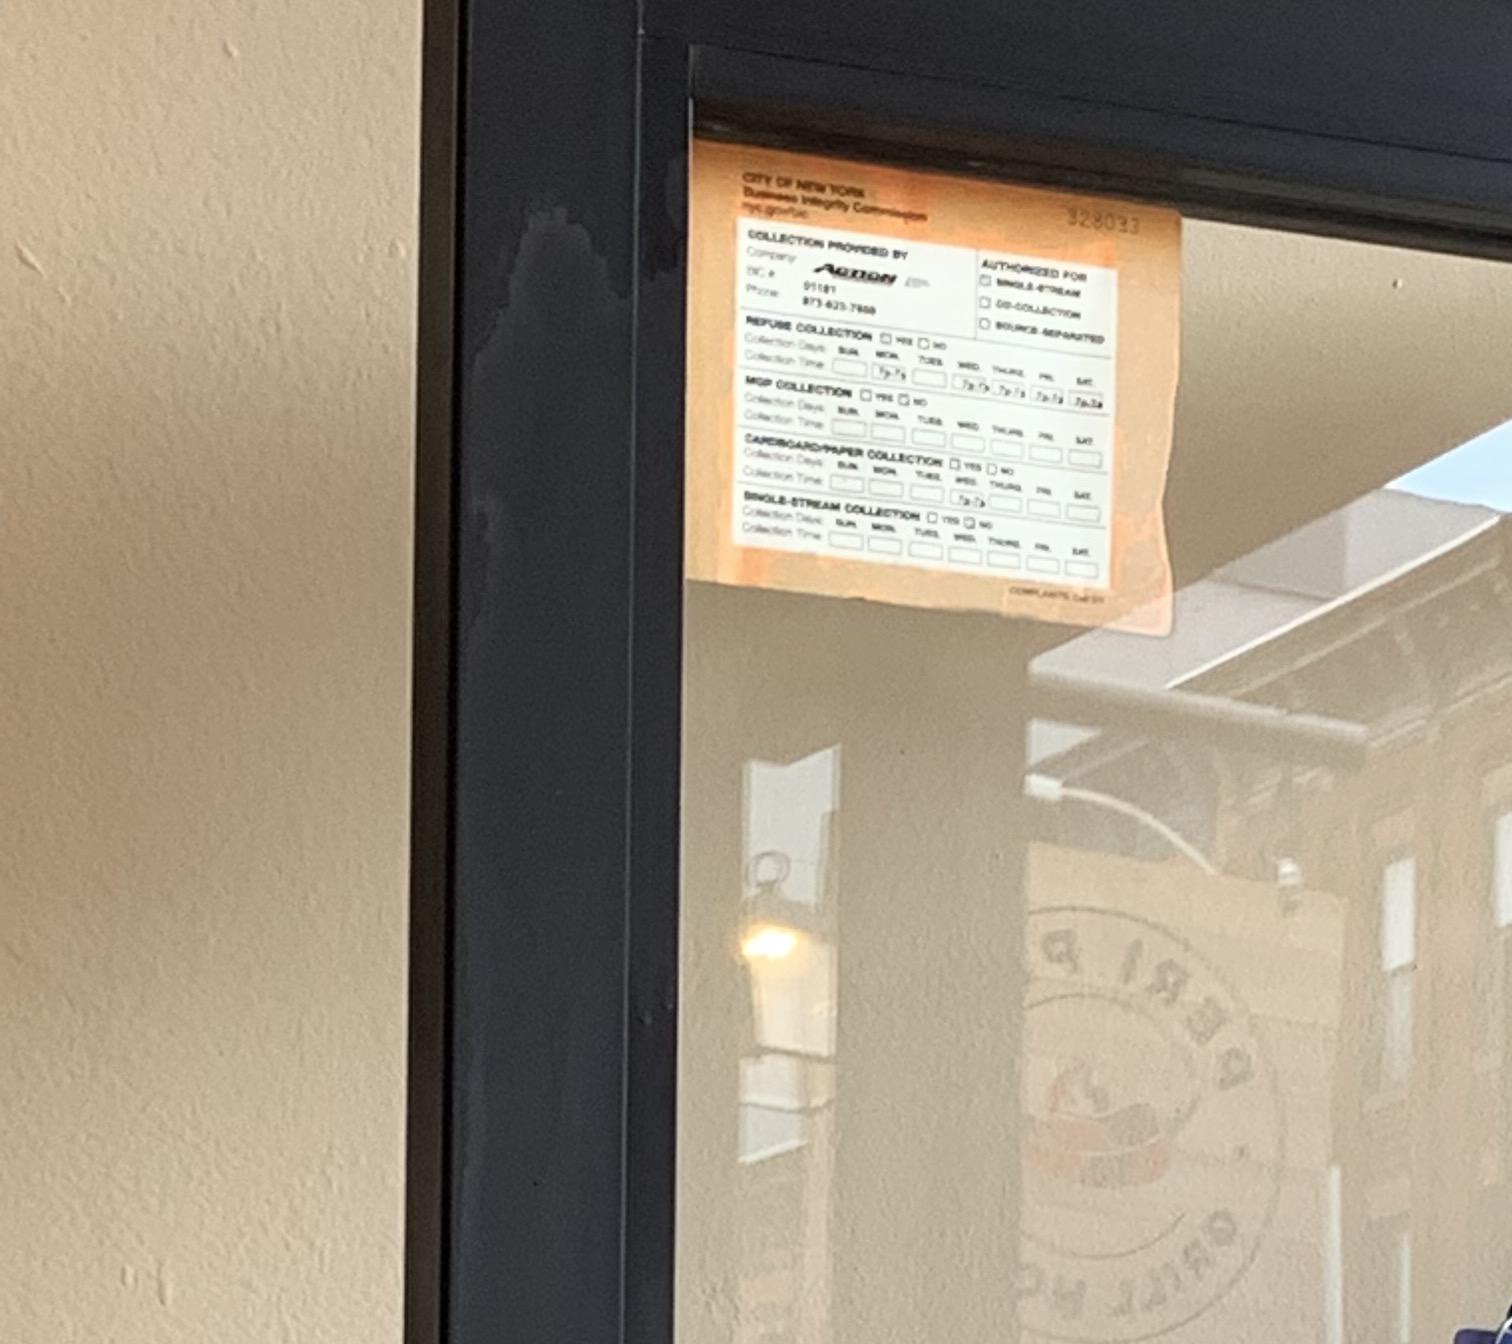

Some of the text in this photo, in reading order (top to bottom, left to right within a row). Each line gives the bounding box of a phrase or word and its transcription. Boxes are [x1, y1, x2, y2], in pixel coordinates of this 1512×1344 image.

[748, 229, 909, 260] COLLECTION PROVIDED BY
[982, 259, 1088, 282] AUTHORIZED FOR
[746, 315, 792, 331] REFUSE
[796, 322, 873, 341] COLLECTION
[776, 379, 853, 398] COLLECTION
[867, 449, 944, 467] COLLECTION
[844, 503, 921, 522] COLLECTION
